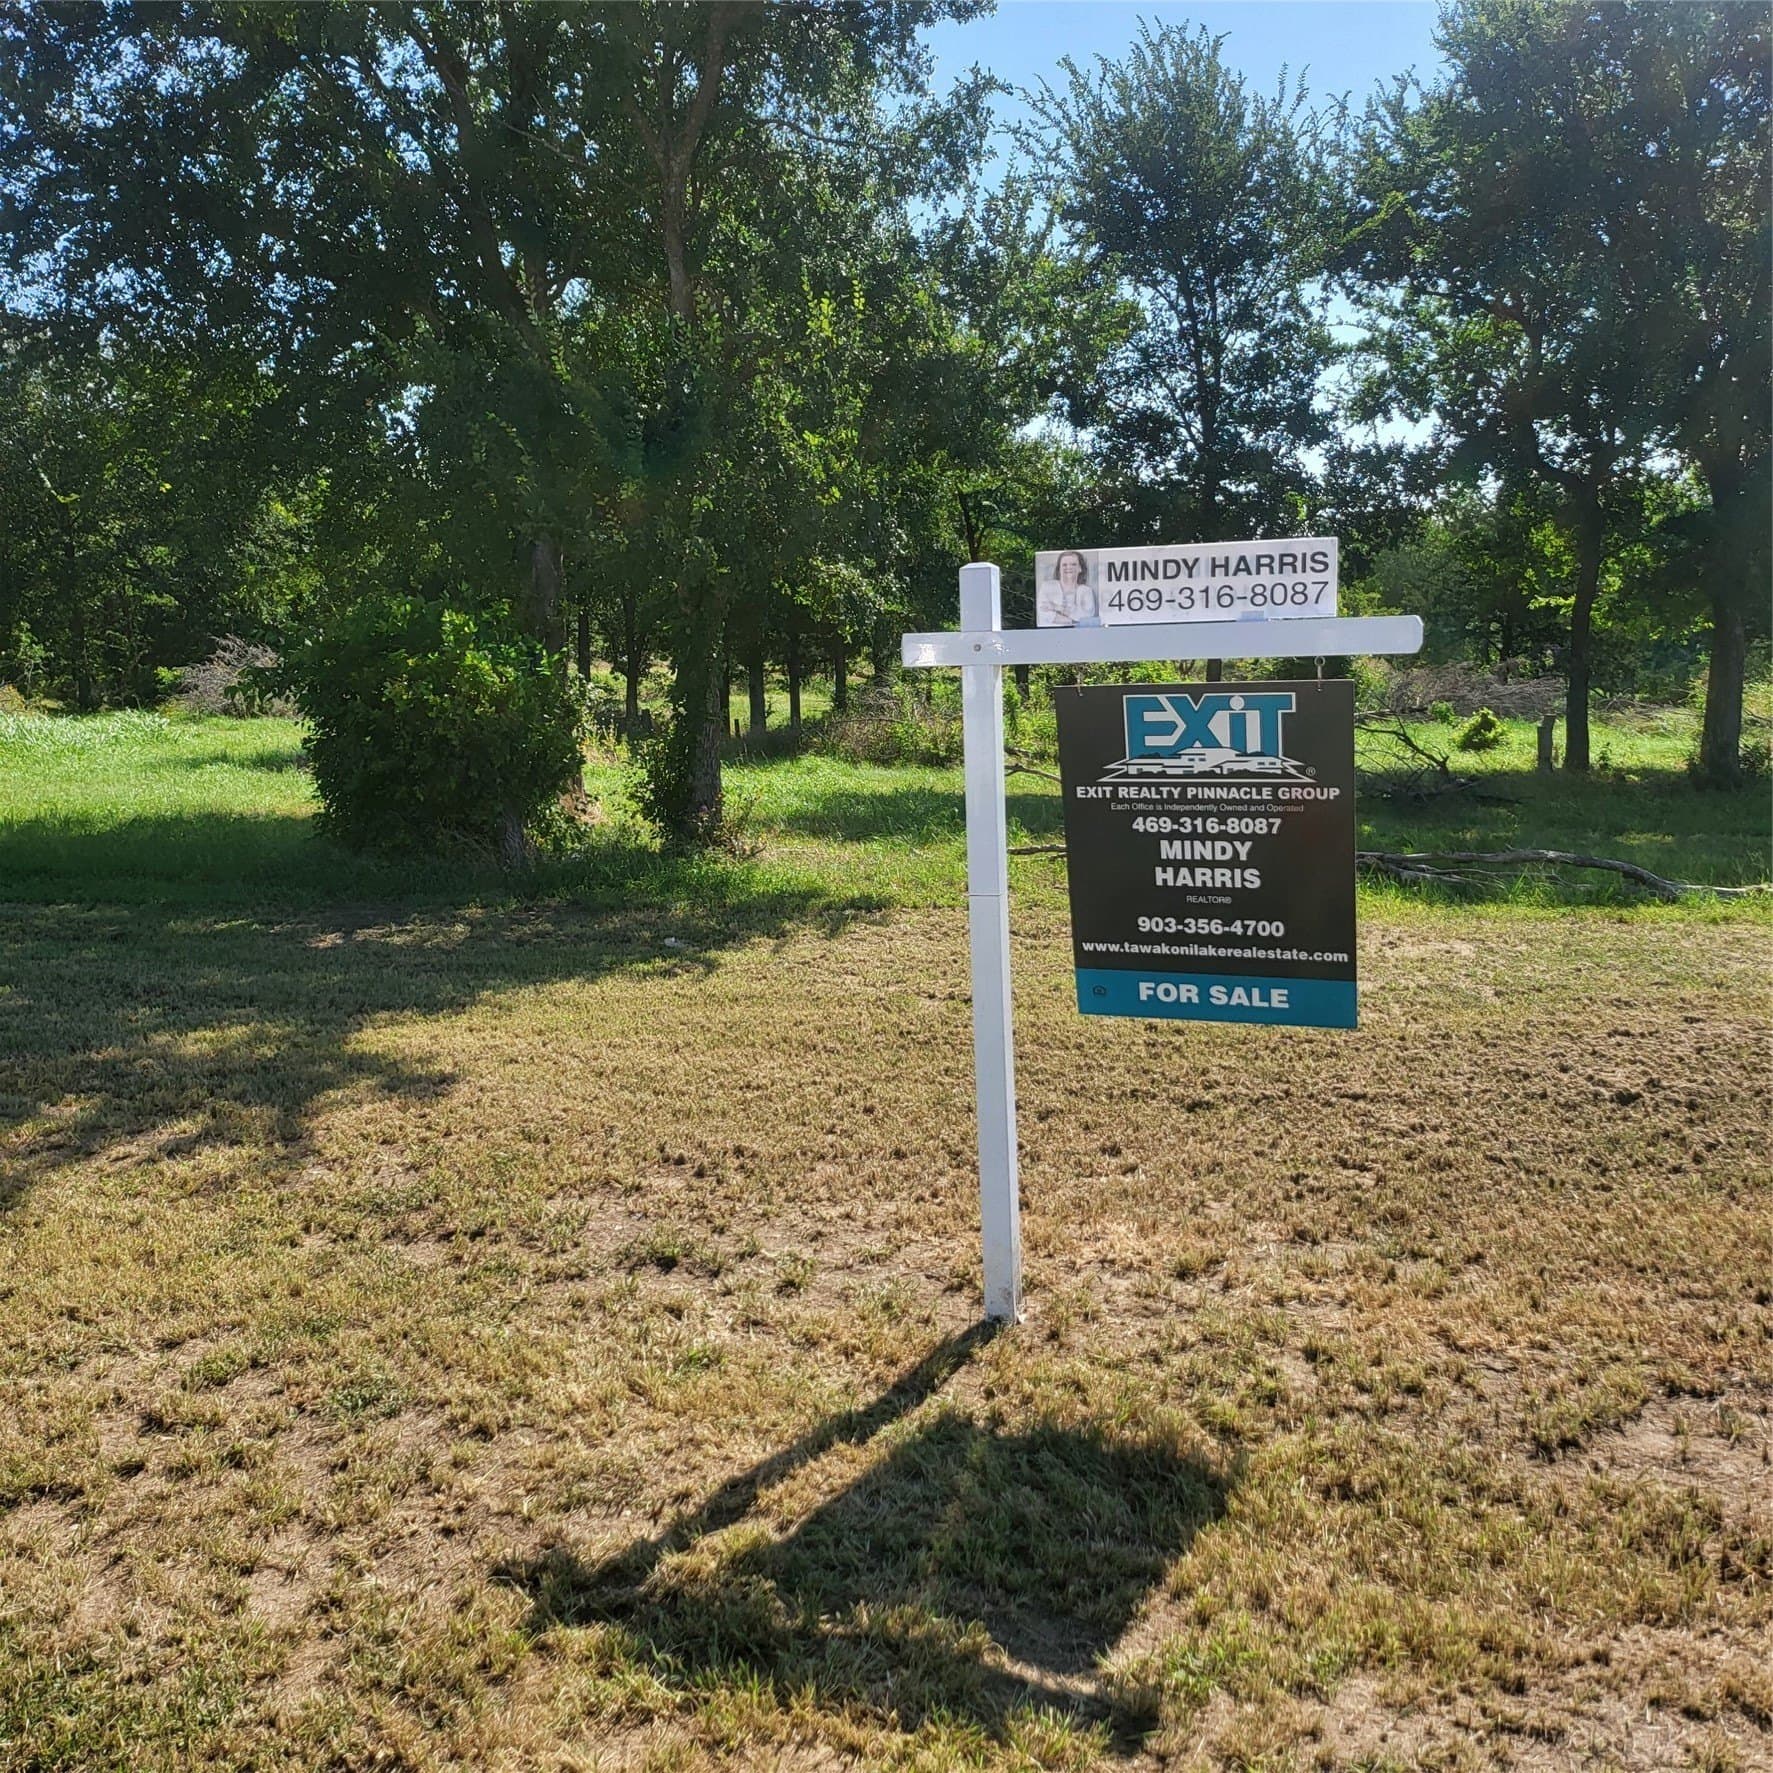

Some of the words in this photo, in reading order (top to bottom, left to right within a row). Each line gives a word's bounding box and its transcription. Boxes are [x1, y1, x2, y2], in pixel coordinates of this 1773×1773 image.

[1107, 557, 1200, 582] MINDY
[1210, 551, 1329, 577] HARRIS
[1108, 581, 1329, 612] 469-316-8087
[1076, 786, 1113, 799] EXIT
[1118, 786, 1182, 799] REALTY
[1187, 787, 1273, 800] PINNACLE
[1277, 787, 1341, 800] GROUP
[1111, 802, 1130, 811] Each
[1131, 802, 1154, 811] Office
[1156, 803, 1162, 811] is
[1164, 803, 1217, 813] Independently
[1219, 803, 1248, 812] Owned
[1250, 803, 1265, 812] and
[1266, 804, 1304, 813] Operated
[1132, 816, 1282, 834] 469-316-8087
[1159, 840, 1252, 861] MINDY
[1155, 867, 1261, 888] HARRIS
[1137, 916, 1284, 937] 903-356-4700
[1082, 941, 1348, 962] www.tawakonilakerealestate.com
[1138, 982, 1199, 1003] FOR
[1209, 986, 1289, 1008] SALE
